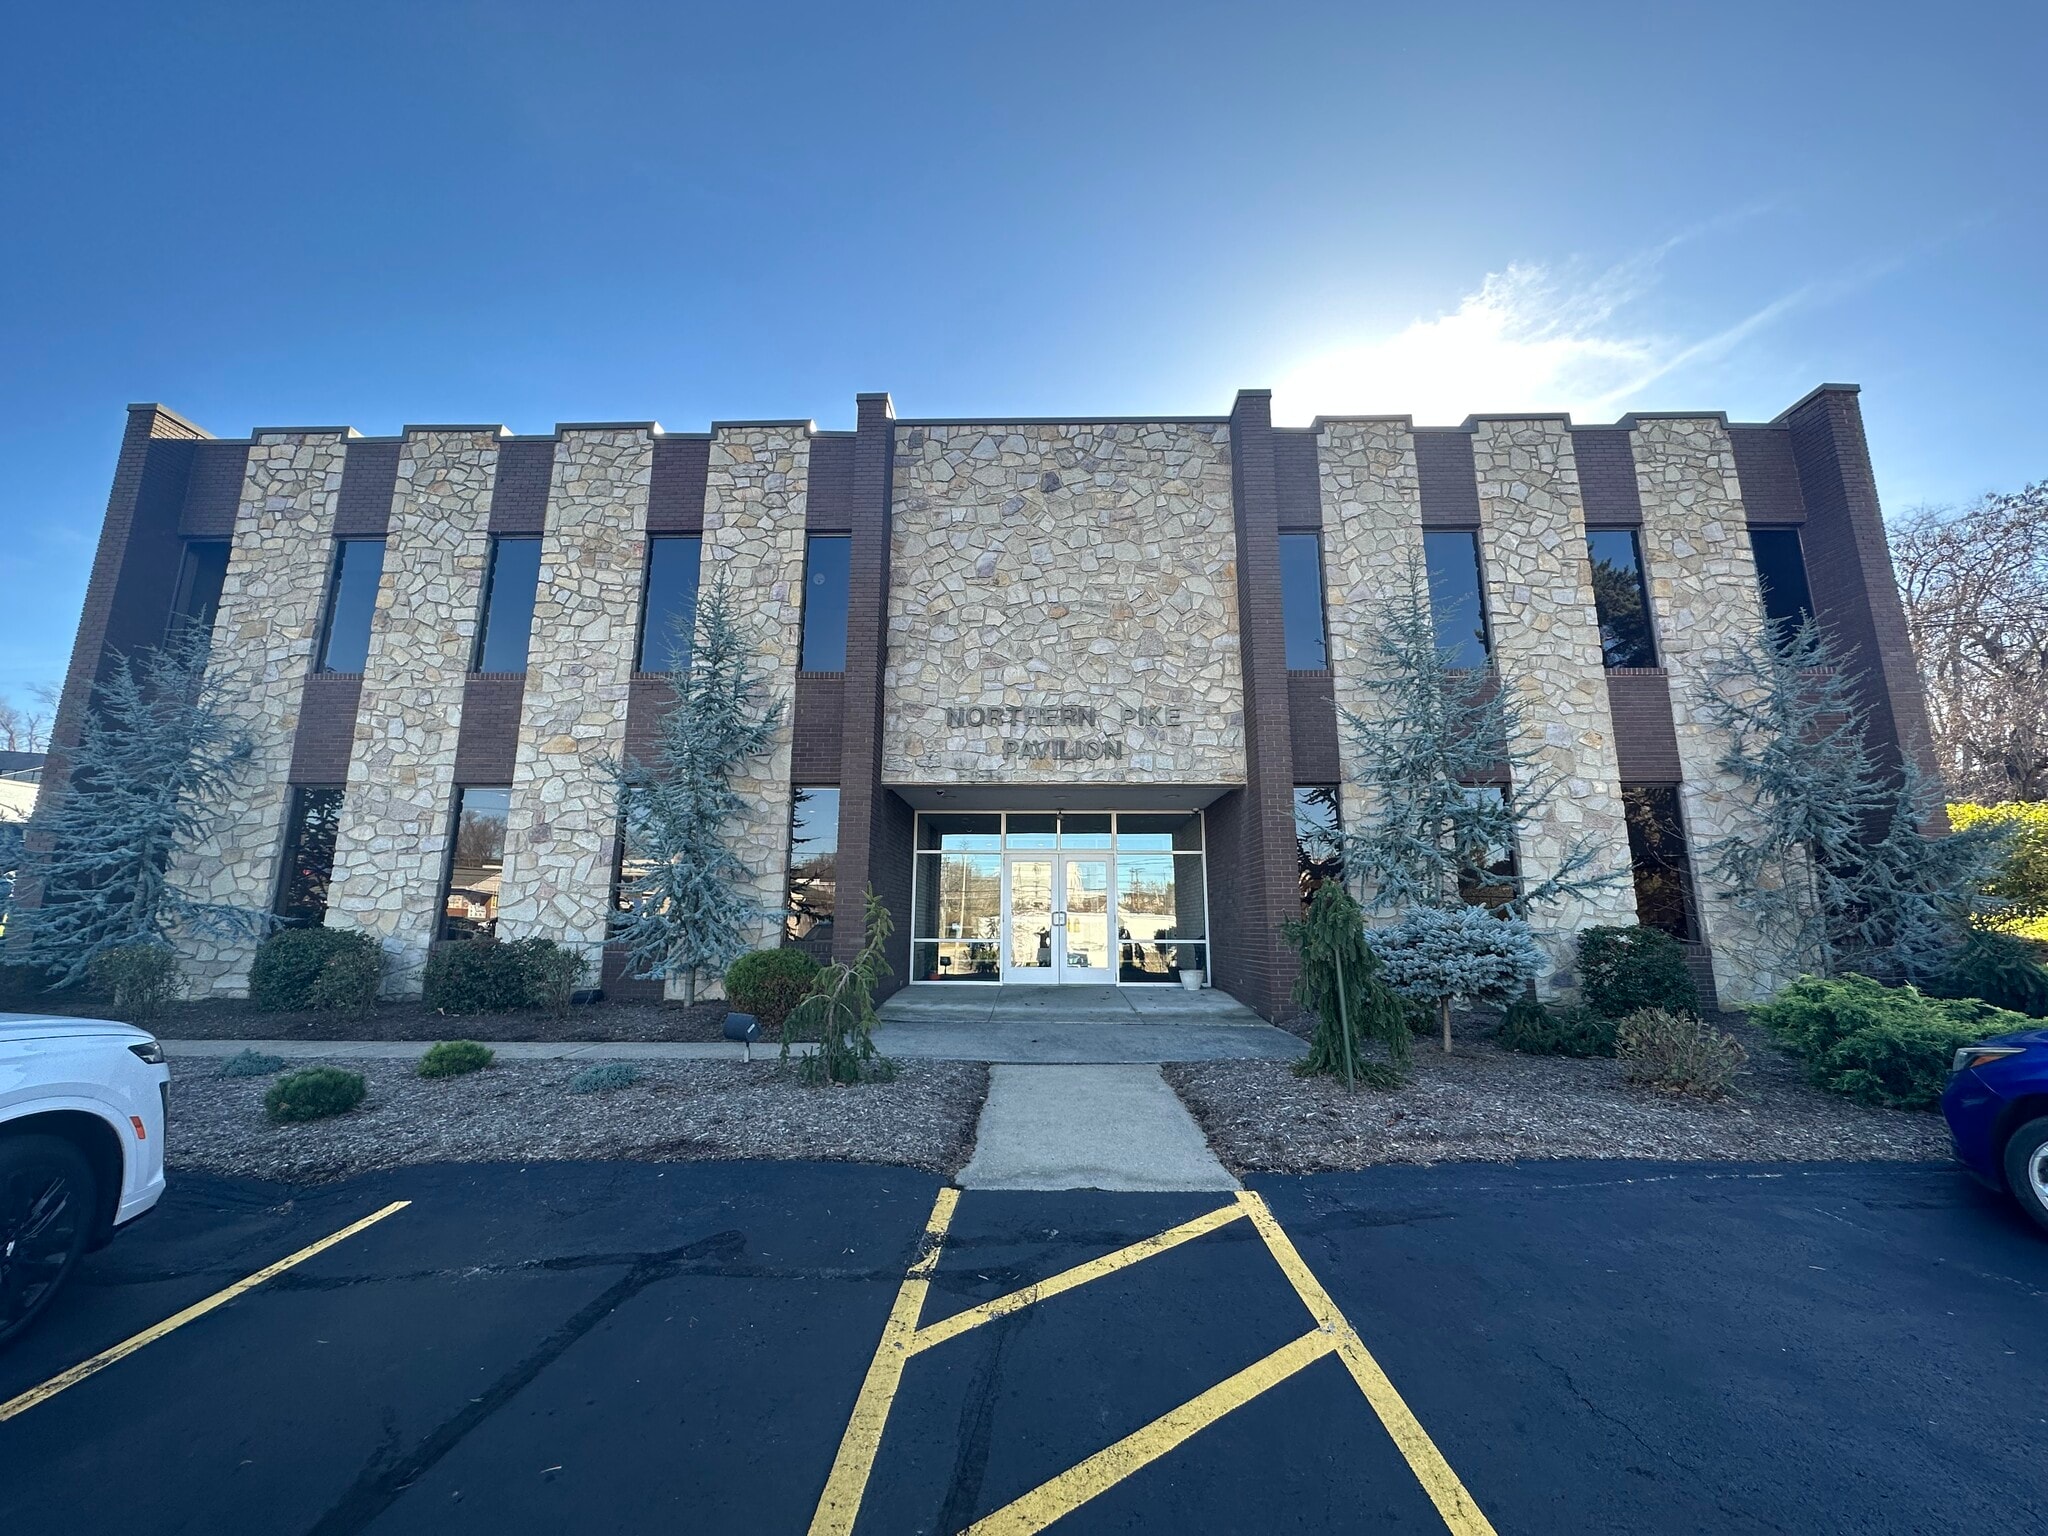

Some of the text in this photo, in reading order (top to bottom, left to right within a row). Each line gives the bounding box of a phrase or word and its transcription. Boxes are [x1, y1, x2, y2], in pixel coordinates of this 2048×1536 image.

[947, 706, 1181, 727] NORTHERN PIKE
[1002, 739, 1122, 760] PAVILION
